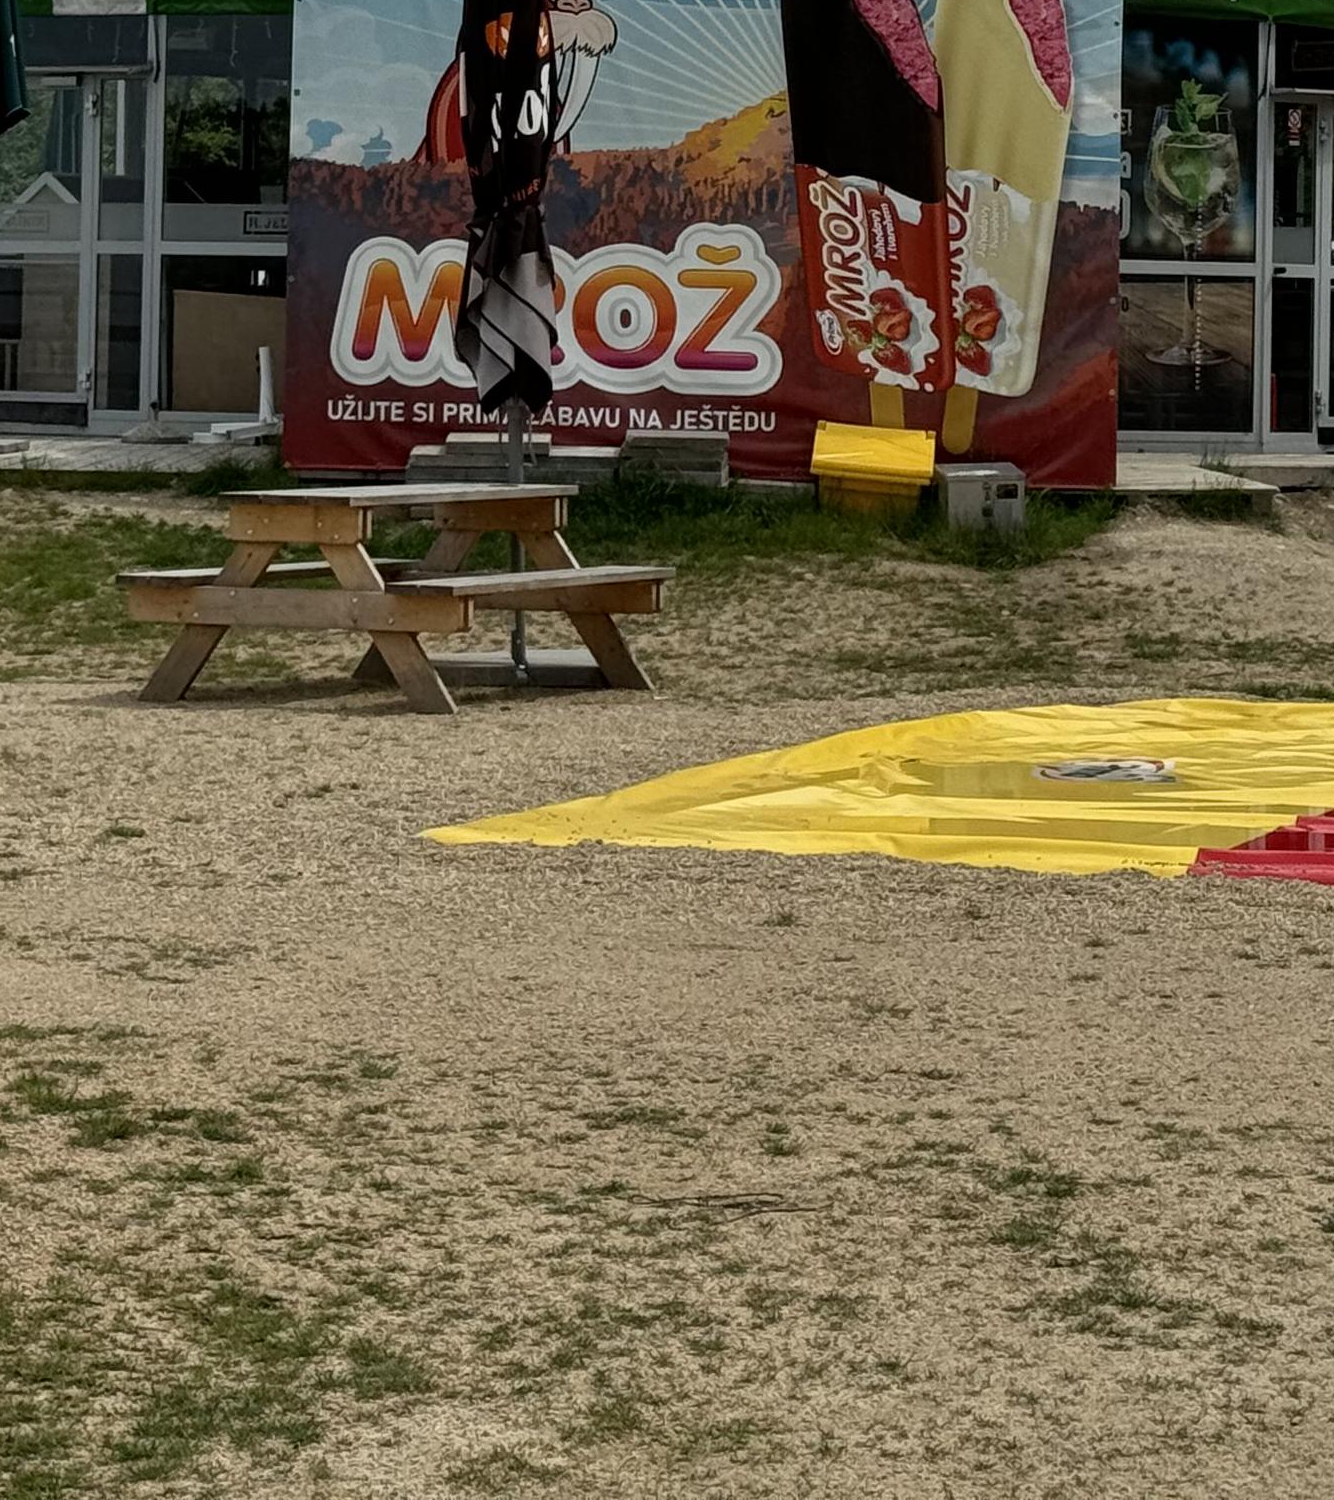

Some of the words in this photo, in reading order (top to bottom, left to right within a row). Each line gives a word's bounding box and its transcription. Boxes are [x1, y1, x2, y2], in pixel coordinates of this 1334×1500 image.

[347, 240, 763, 375] MOŽ
[327, 394, 405, 422] UŽIJTE
[412, 401, 435, 423] SI
[629, 408, 663, 429] NA
[670, 405, 776, 432] JEŠTĚDU
